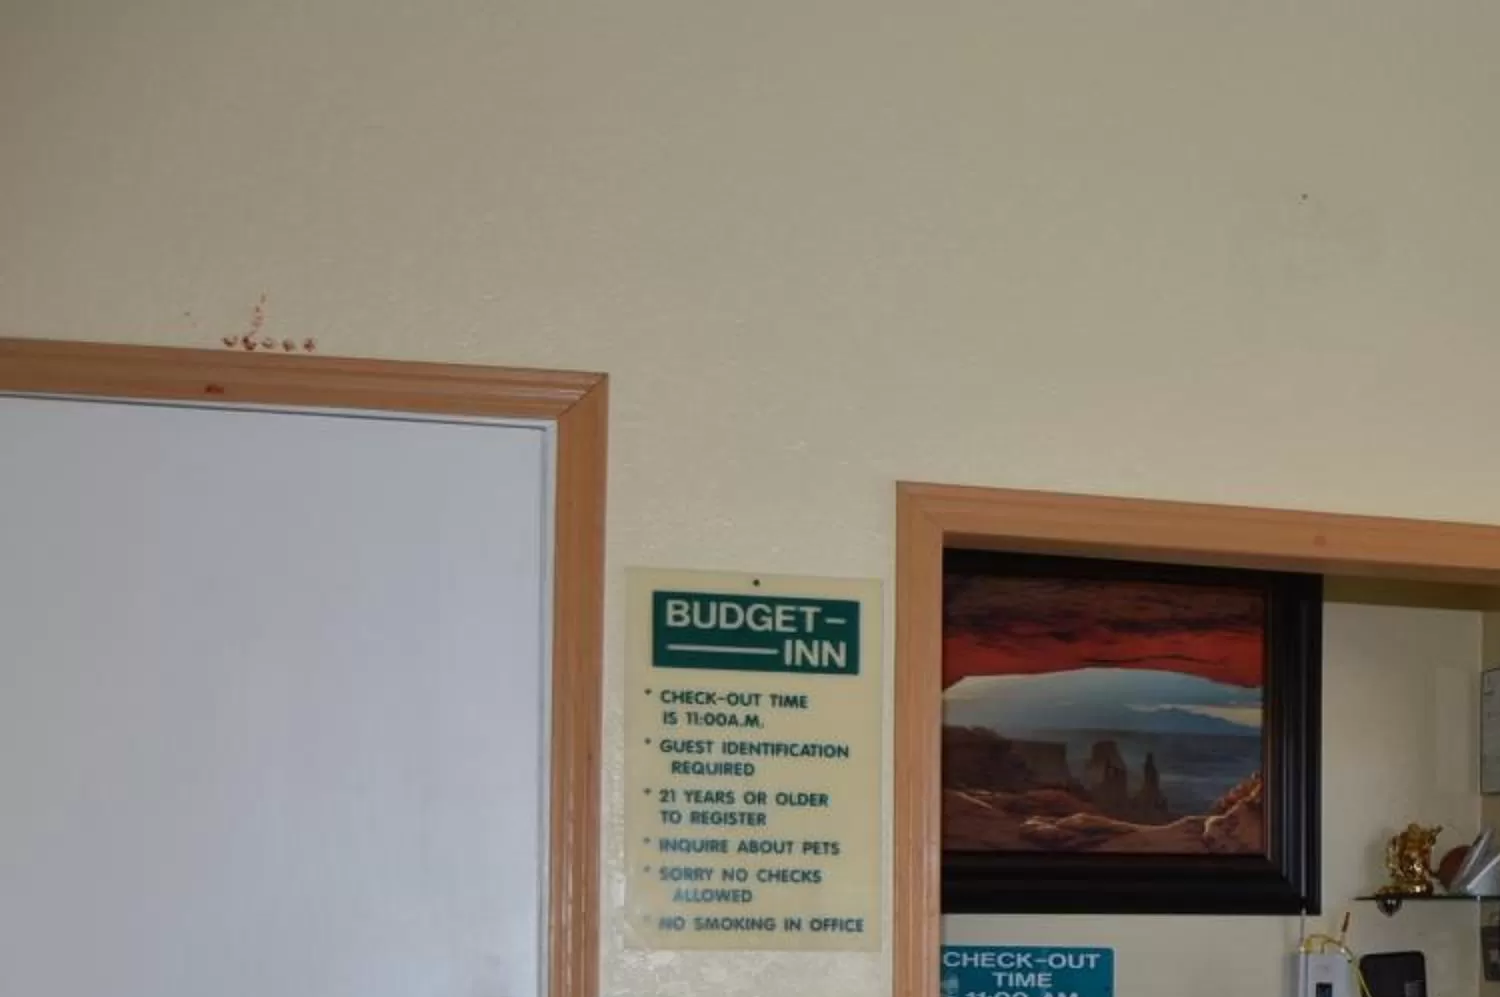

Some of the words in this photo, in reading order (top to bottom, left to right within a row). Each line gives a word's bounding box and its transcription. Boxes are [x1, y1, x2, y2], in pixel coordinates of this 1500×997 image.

[784, 640, 846, 668] INN
[660, 689, 762, 707] CHECK-OUT
[769, 693, 809, 709] TIME
[663, 711, 678, 726] IS
[660, 739, 714, 755] GUEST
[721, 740, 849, 759] IDENTIFICATION
[671, 760, 755, 777] REQUIRED
[659, 789, 676, 803] 21
[684, 790, 736, 806] YEARS
[743, 791, 767, 806] OR
[775, 791, 829, 807] OLDER
[661, 811, 682, 825] TO
[690, 811, 767, 827] REGISTER
[659, 838, 729, 854] INQUIRE
[737, 839, 794, 855] ABOUT
[802, 840, 841, 856] PETS
[659, 867, 714, 883] SORRY
[721, 868, 749, 883] NO
[757, 868, 823, 884] CHECKS
[673, 888, 753, 904] ALLOWED
[659, 916, 686, 931] NO
[694, 916, 777, 932] SMOKING
[783, 917, 801, 932] IN
[809, 917, 865, 934] OFFICE
[943, 951, 1101, 969] CHECK-OUT
[991, 971, 1053, 988] TIME
